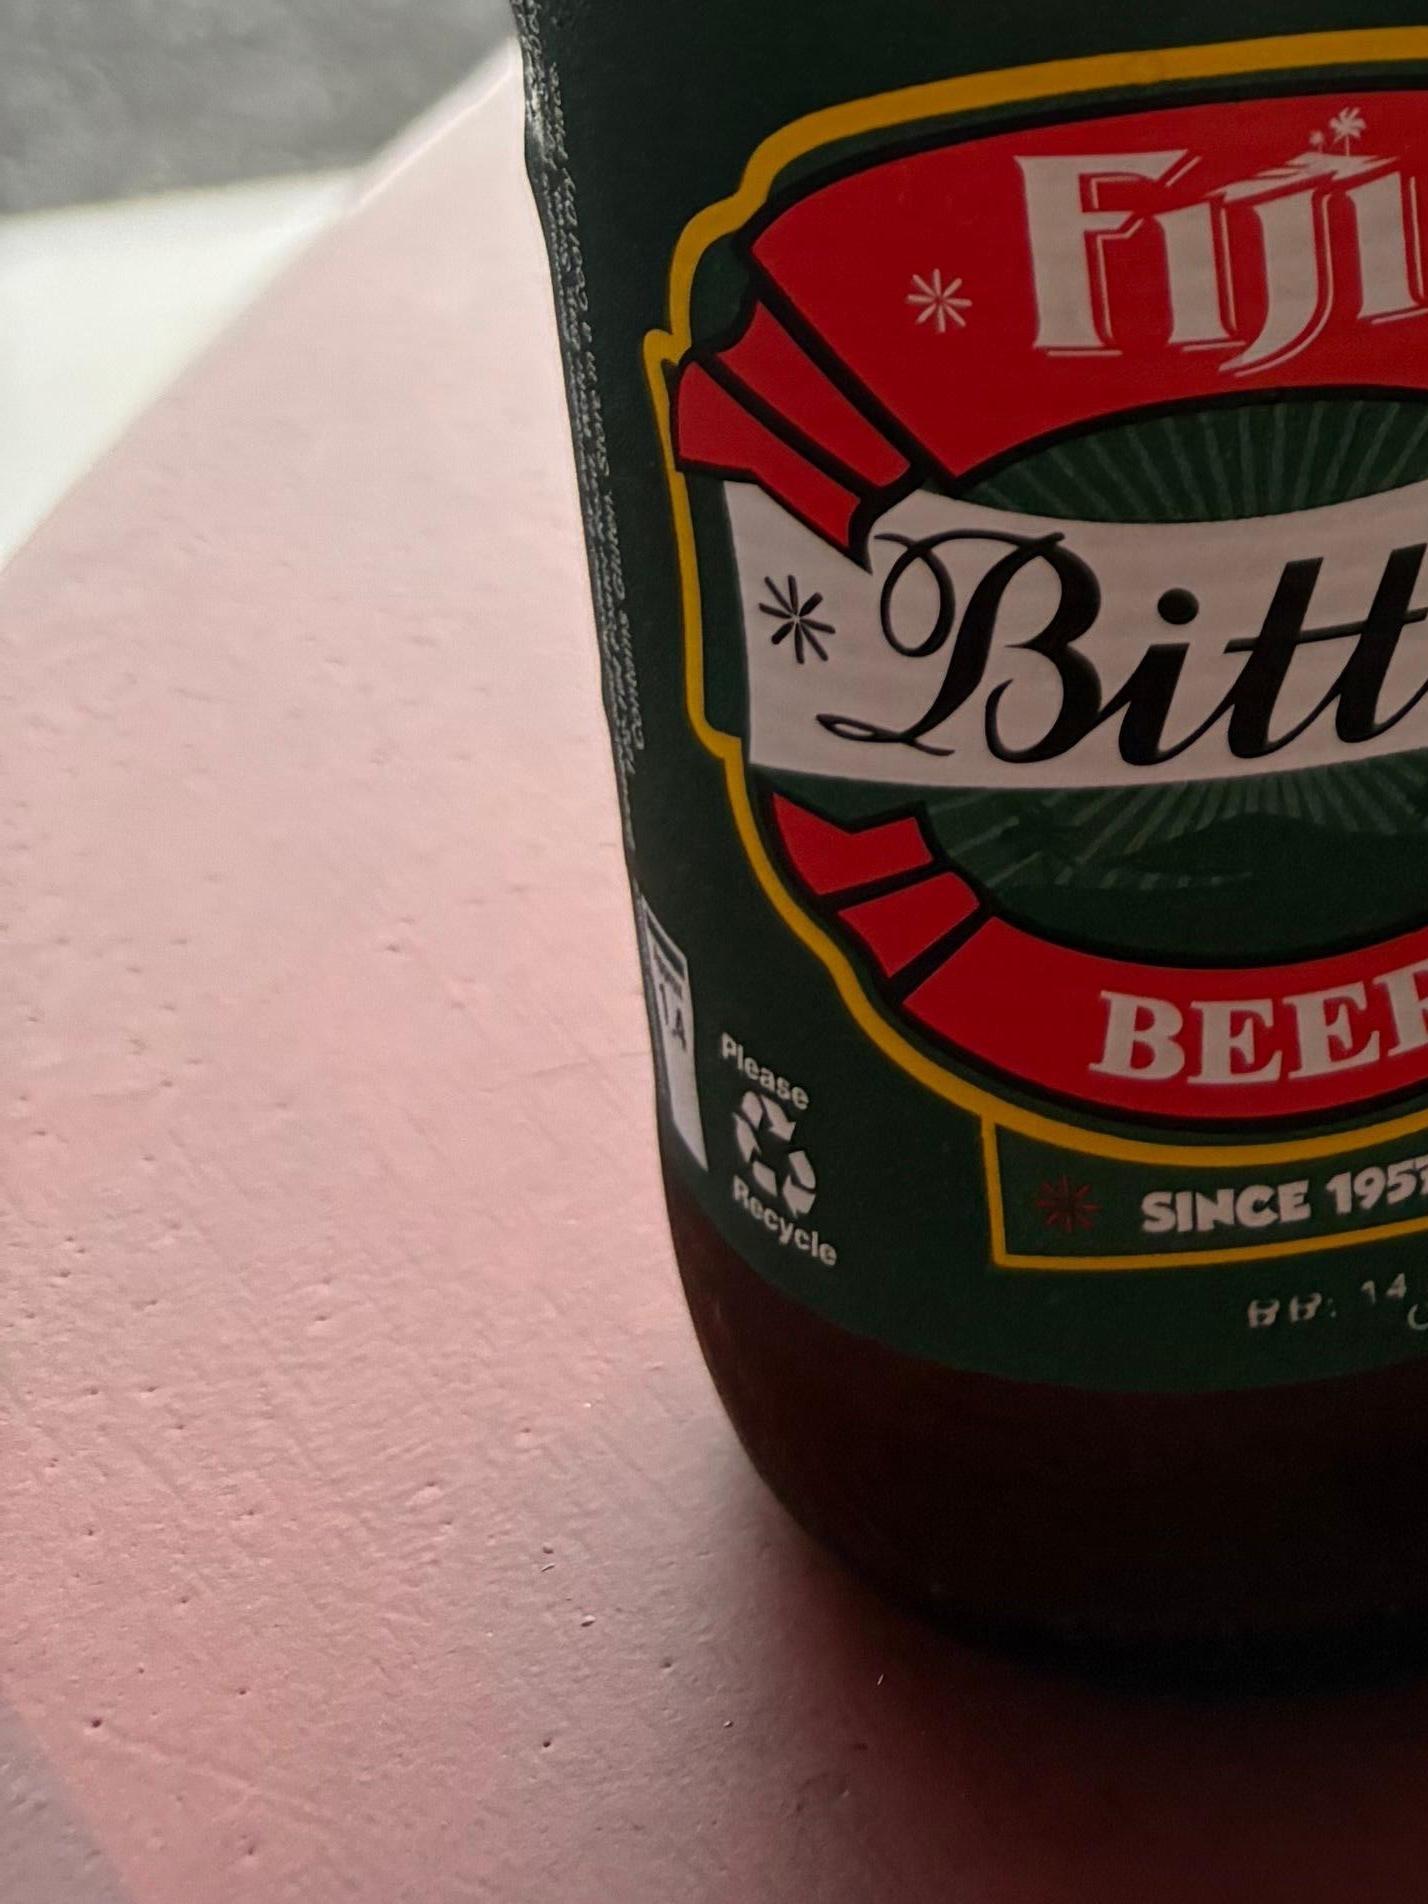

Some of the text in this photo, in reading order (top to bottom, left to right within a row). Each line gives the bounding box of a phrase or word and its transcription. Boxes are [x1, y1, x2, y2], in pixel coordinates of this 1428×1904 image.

[721, 1030, 811, 1112] Please
[733, 1173, 838, 1269] Recycle
[1140, 1179, 1312, 1234] SINCE
